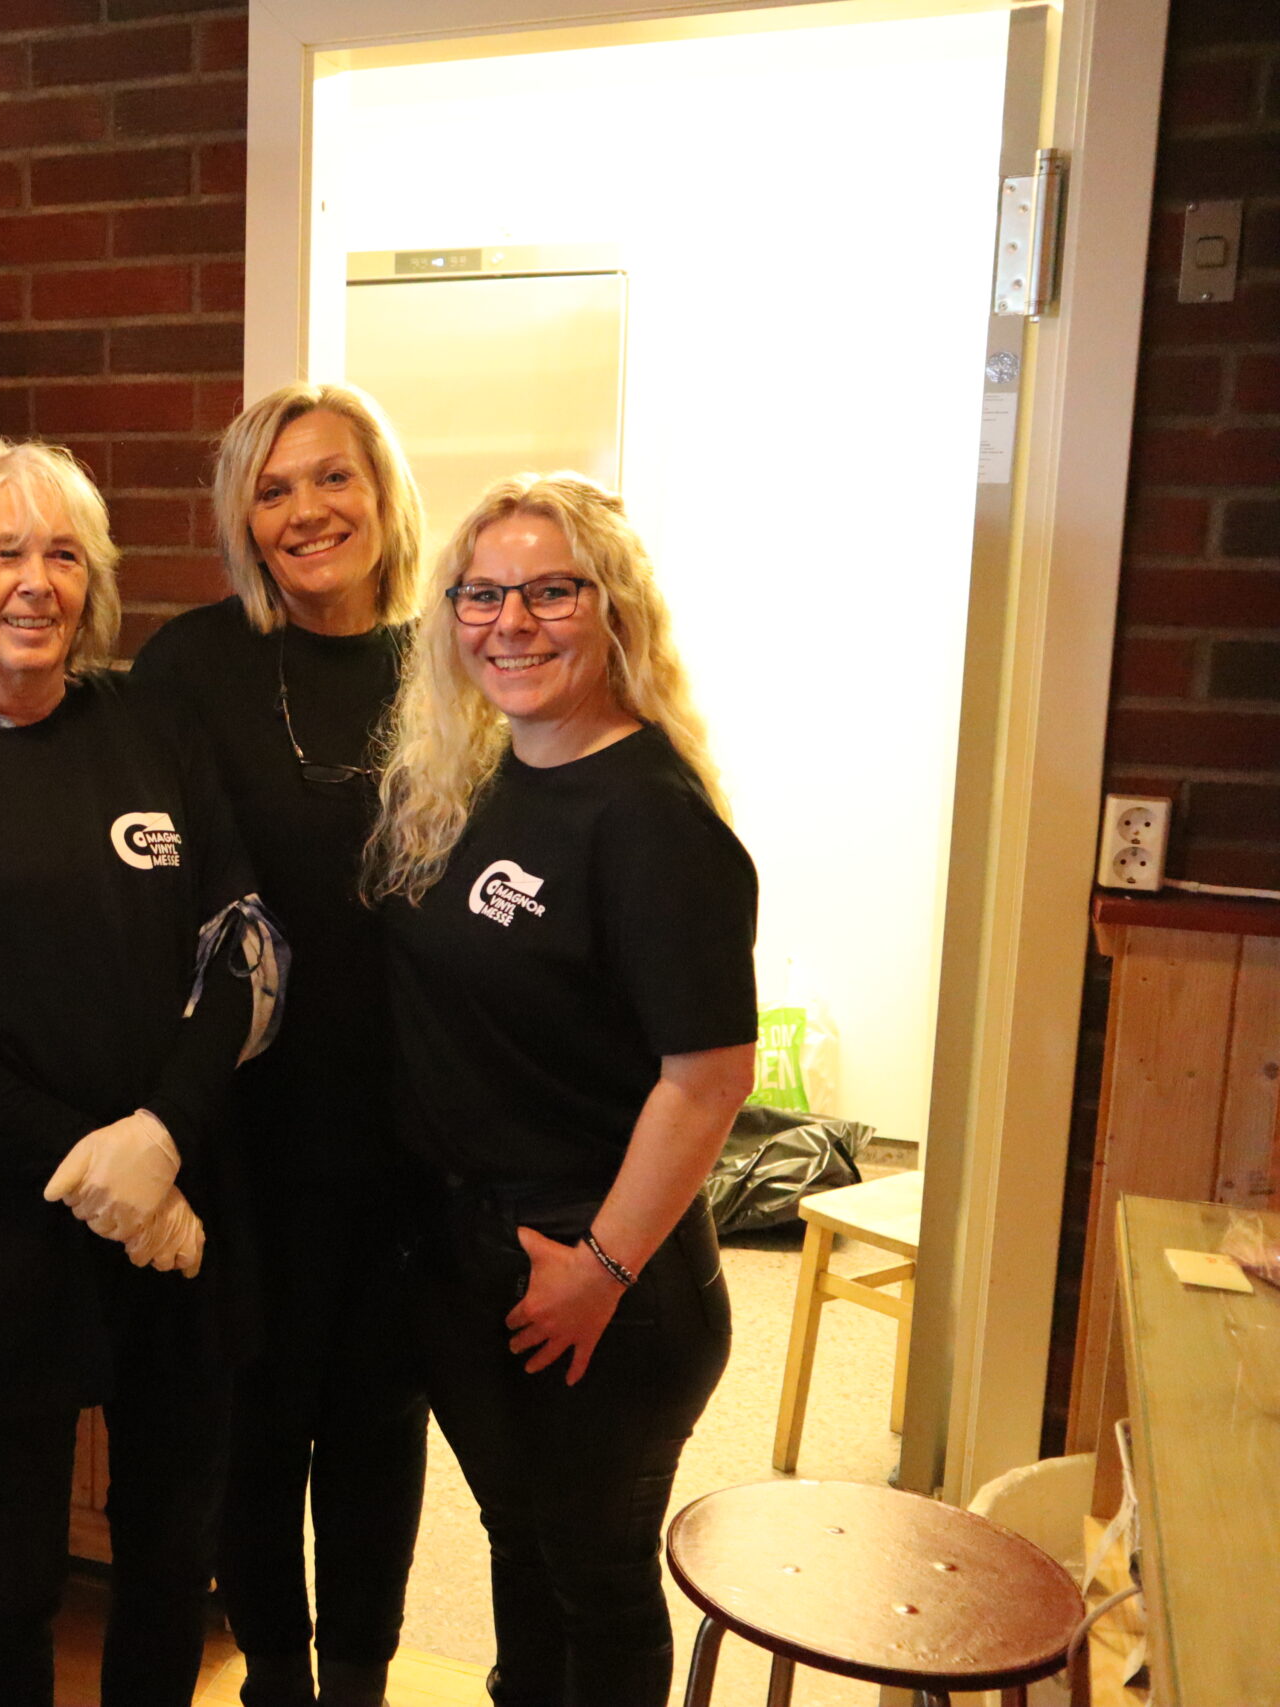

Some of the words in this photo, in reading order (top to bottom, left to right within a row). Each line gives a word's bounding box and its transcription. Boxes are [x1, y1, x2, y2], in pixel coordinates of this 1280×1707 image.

[145, 832, 182, 844] MAGNO
[150, 843, 178, 854] VINYL
[153, 855, 180, 866] MESSE
[489, 895, 517, 915] VINYL
[496, 885, 546, 917] MAGNOR
[481, 904, 514, 927] MESSE
